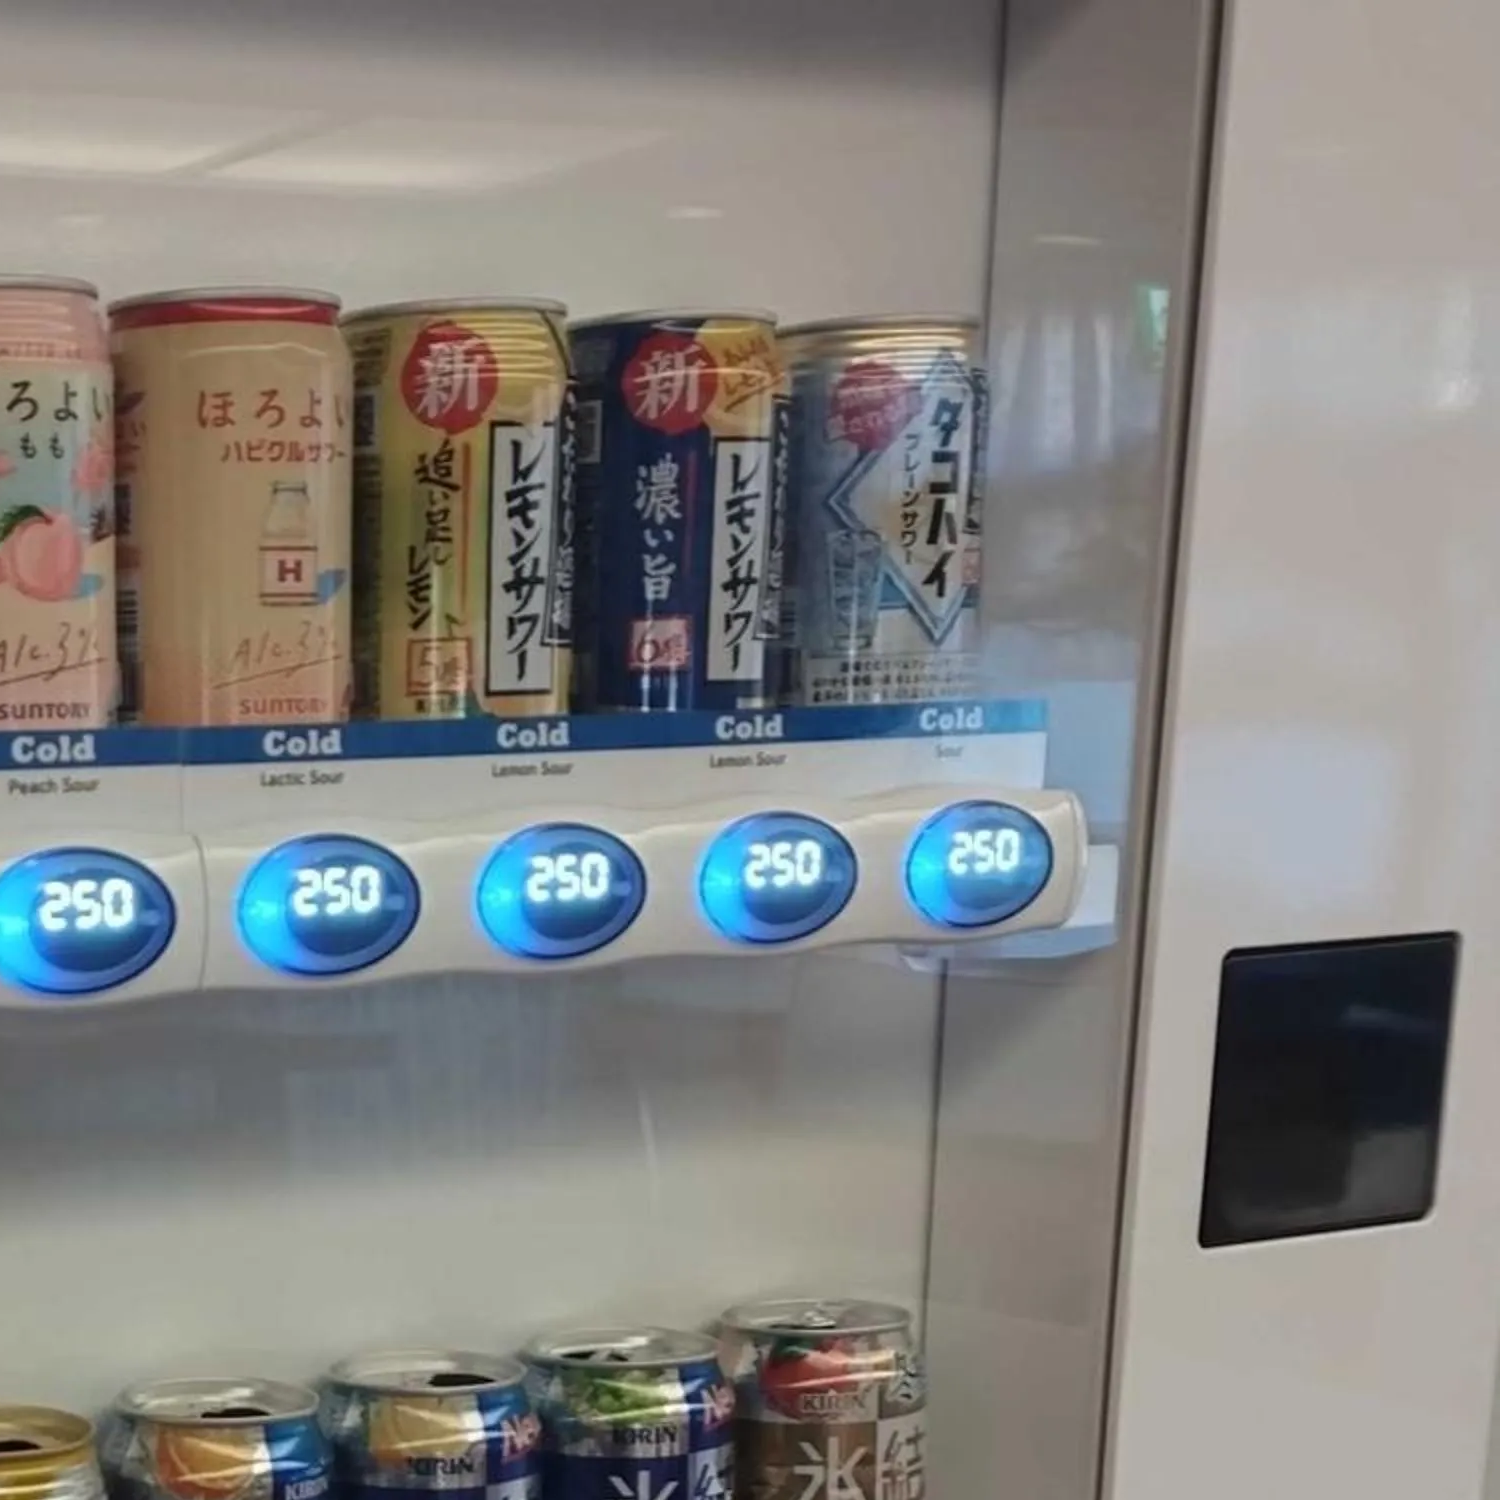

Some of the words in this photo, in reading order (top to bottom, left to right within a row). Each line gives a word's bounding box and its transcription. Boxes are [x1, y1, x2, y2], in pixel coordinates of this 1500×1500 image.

[416, 337, 483, 418] 新
[634, 344, 706, 420] 新
[19, 433, 64, 459] もも
[922, 397, 964, 598] タコハイ
[634, 452, 682, 602] 濃い旨
[277, 559, 303, 583] H
[501, 439, 546, 681] レモンサワー
[722, 452, 760, 672] レモンサワー
[239, 699, 326, 715] SUNTORY
[920, 707, 983, 731] Cold
[497, 722, 570, 749] Cold
[715, 714, 784, 740] Cold
[11, 734, 96, 763] Cold
[263, 729, 342, 757] Cold
[936, 744, 963, 759] Sour
[492, 763, 538, 778] Lemon
[541, 761, 573, 776] Sour
[710, 753, 752, 769] Lemon
[756, 752, 786, 767] Sour
[8, 778, 58, 795] Peach
[63, 776, 99, 792] Sour
[260, 771, 304, 787] Lactic
[309, 769, 344, 786] Sour
[743, 840, 822, 889] 250
[948, 828, 1021, 876] 250
[526, 852, 609, 902] 250
[293, 865, 381, 917] 250
[39, 878, 135, 932] 250
[802, 1390, 865, 1413] KIRIN
[612, 1424, 678, 1446] KIRIN
[407, 1456, 476, 1476] KIRIN
